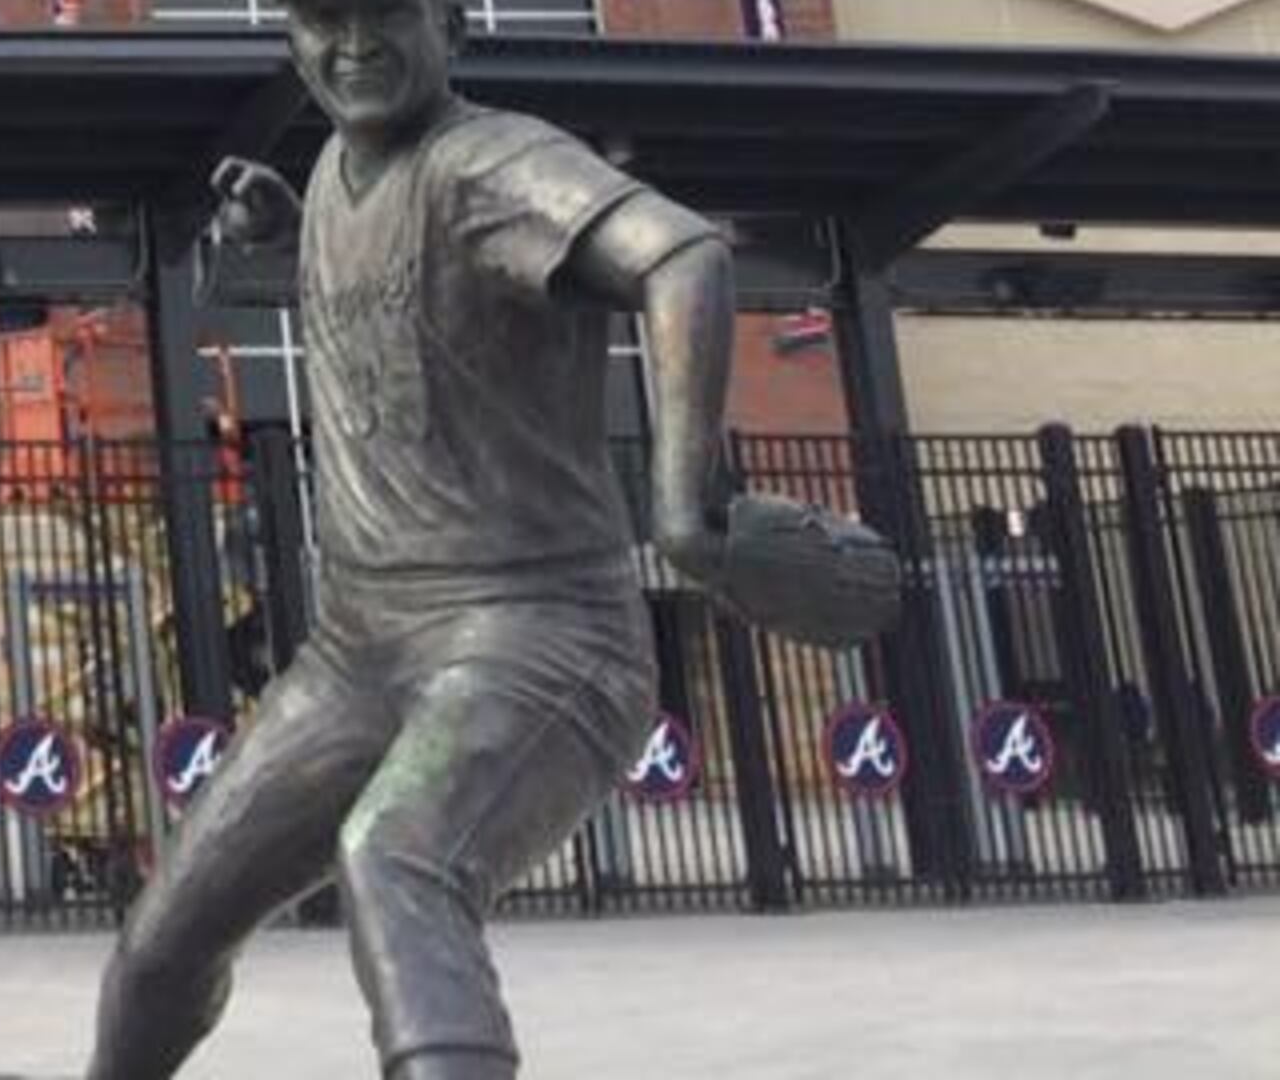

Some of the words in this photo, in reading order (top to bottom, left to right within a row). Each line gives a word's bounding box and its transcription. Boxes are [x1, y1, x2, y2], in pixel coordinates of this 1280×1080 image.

[5, 734, 66, 795] A
[625, 722, 684, 783] A
[838, 717, 895, 778] A
[985, 714, 1043, 774] A
